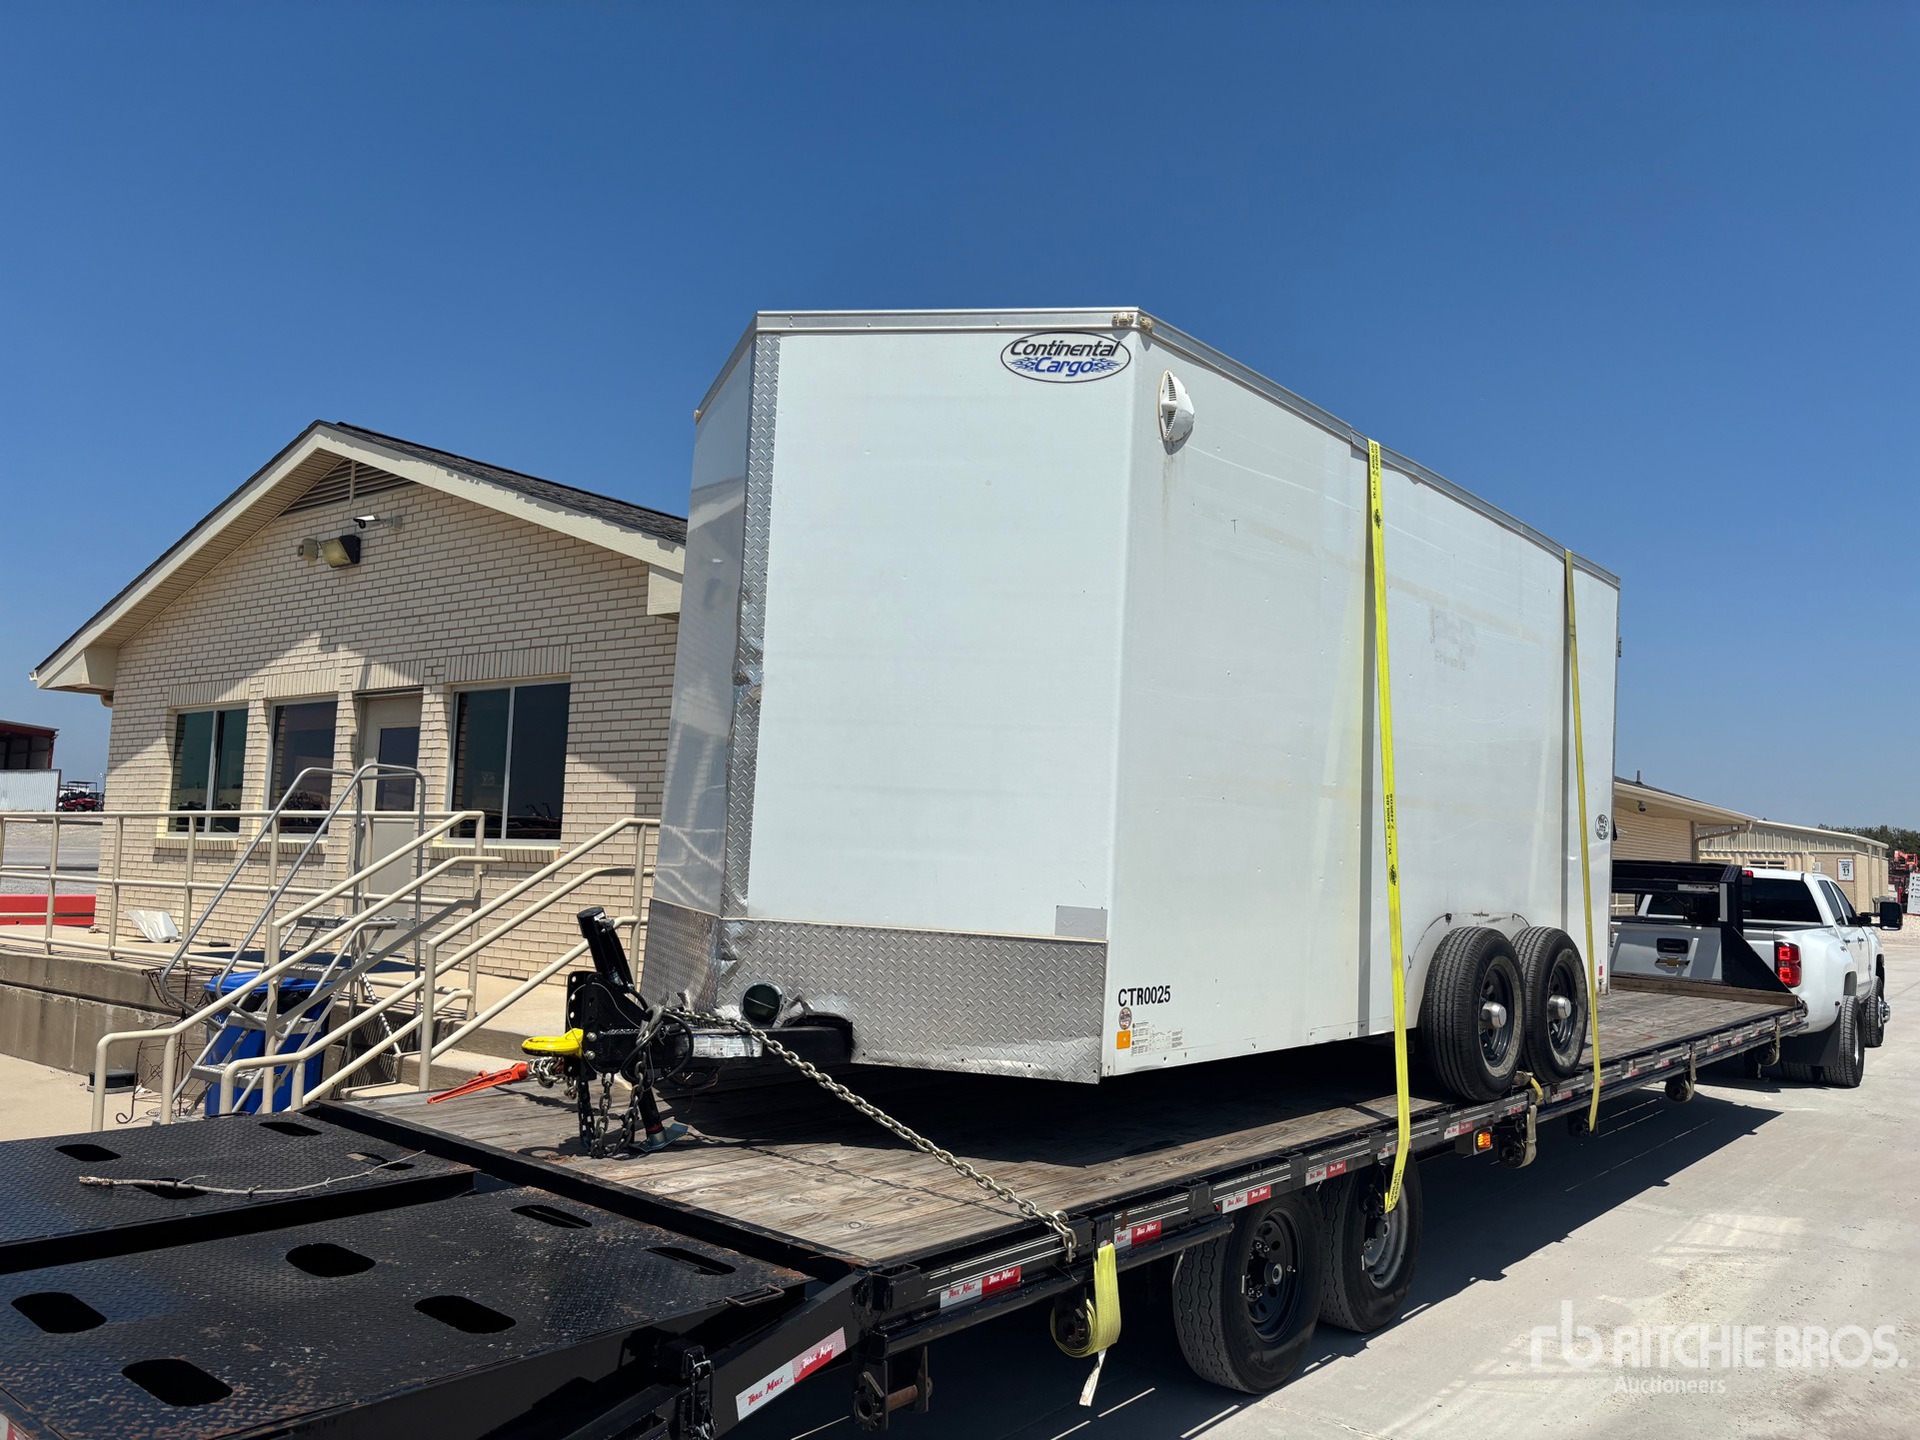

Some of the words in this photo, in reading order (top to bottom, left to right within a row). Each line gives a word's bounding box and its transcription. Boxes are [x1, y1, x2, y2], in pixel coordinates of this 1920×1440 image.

[1010, 340, 1121, 357] Continental
[1034, 357, 1094, 377] Cargo
[1118, 985, 1171, 1007] CTR0025
